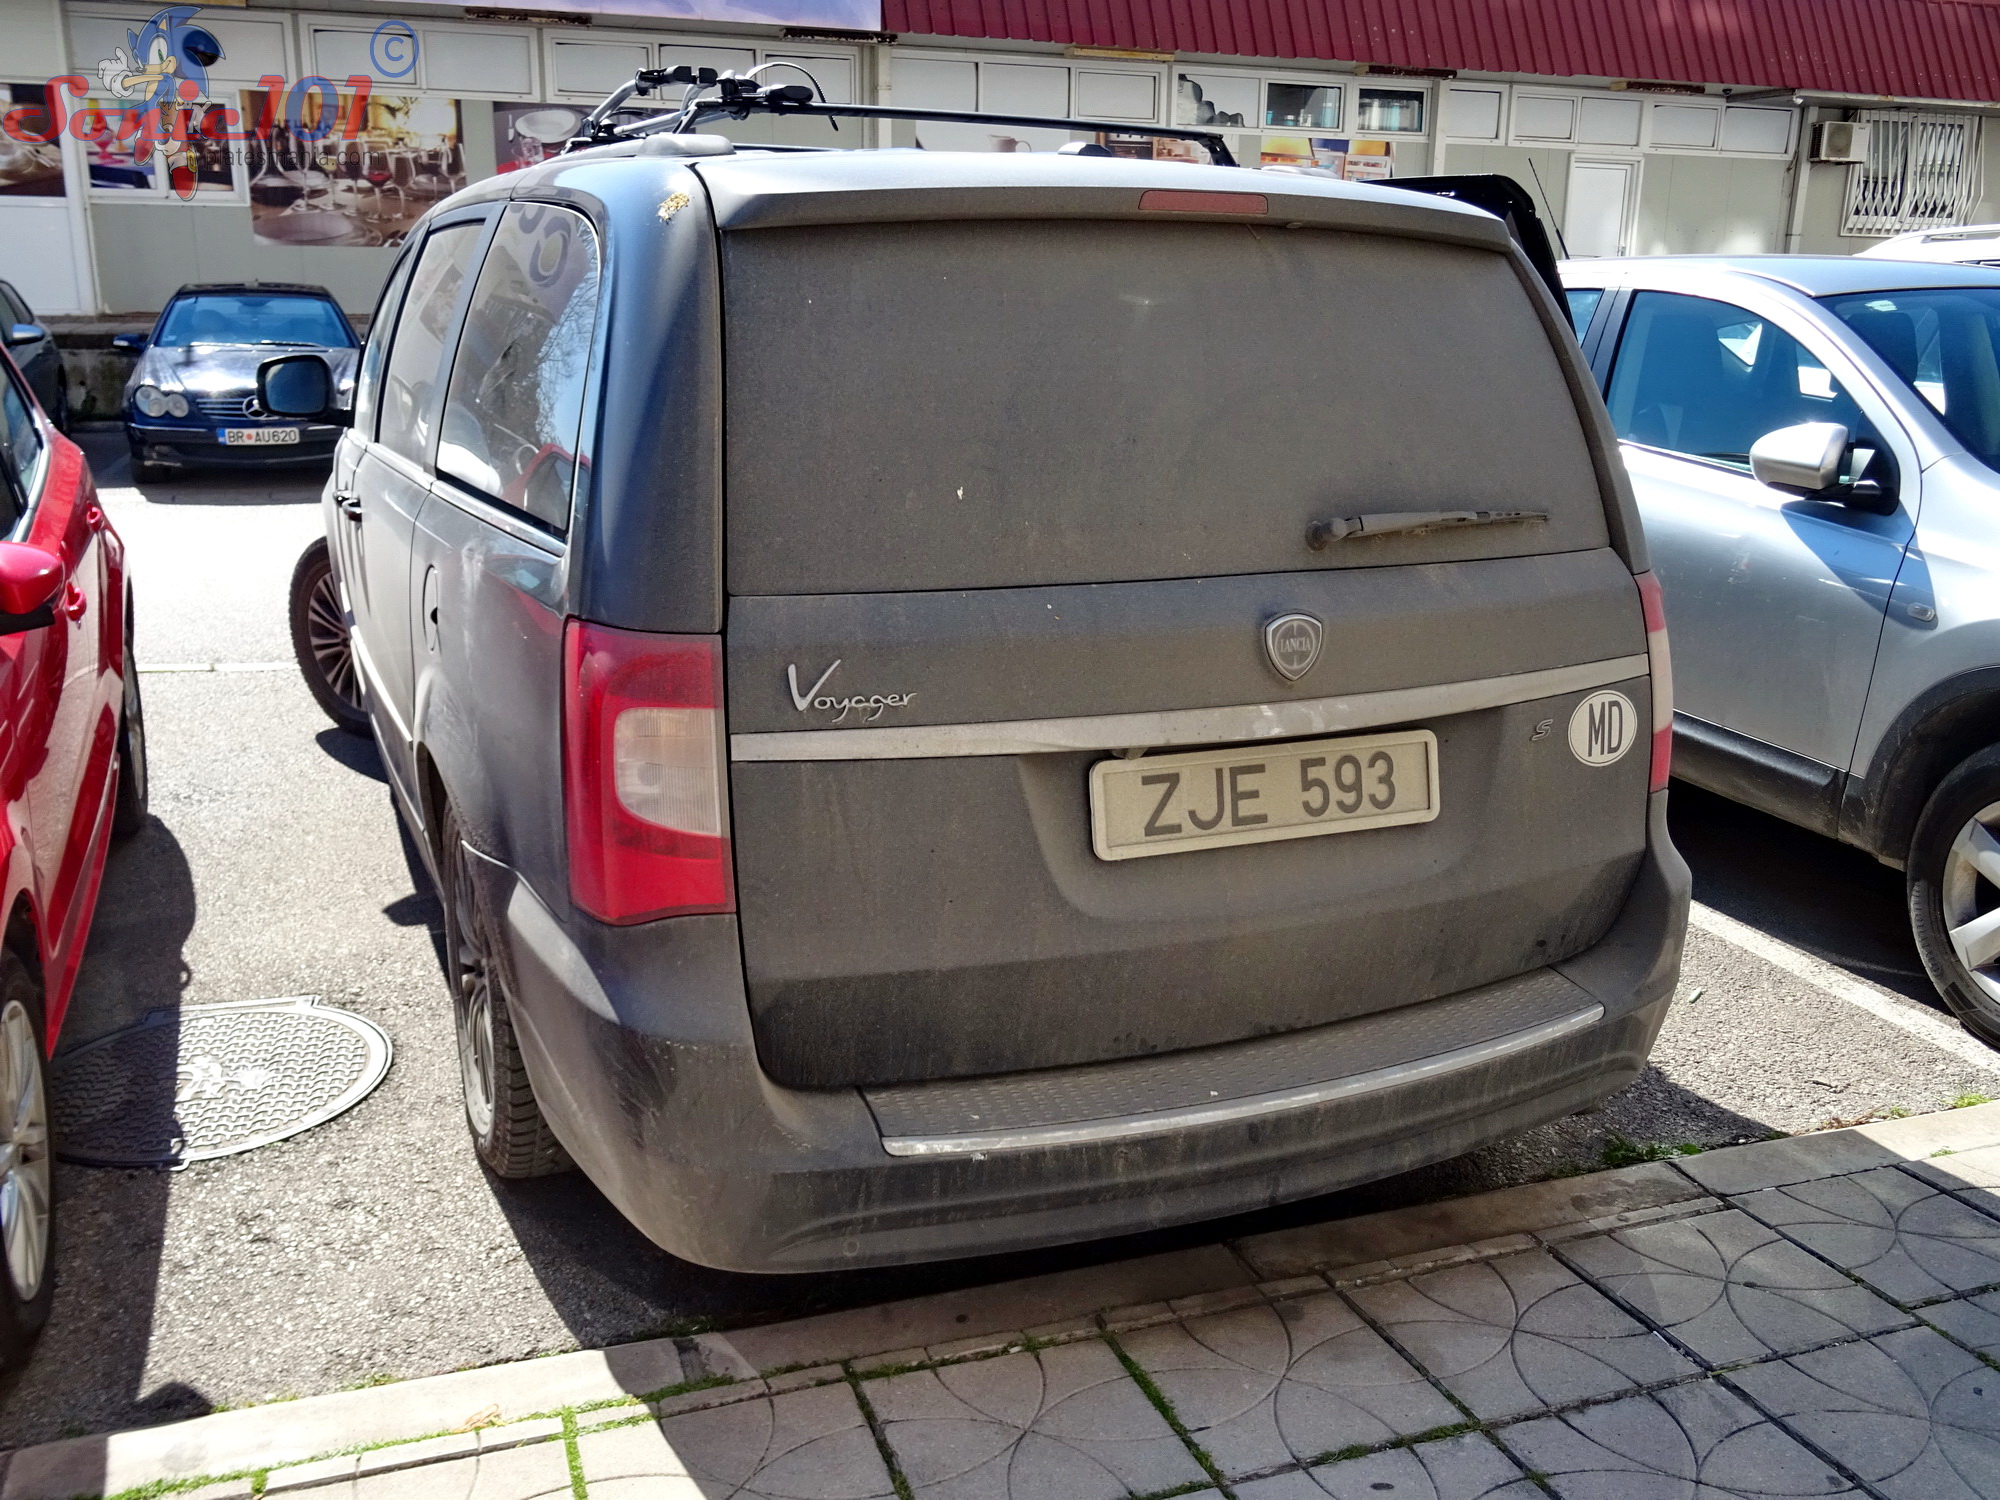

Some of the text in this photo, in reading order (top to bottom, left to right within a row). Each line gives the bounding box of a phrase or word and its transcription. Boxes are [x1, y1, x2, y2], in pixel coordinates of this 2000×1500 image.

[227, 429, 297, 443] BR AU620
[1280, 637, 1311, 653] LANCIA
[787, 658, 918, 723] Voyager
[1530, 718, 1554, 742] S
[1587, 700, 1624, 758] MD
[1141, 750, 1396, 837] ZJE 593
